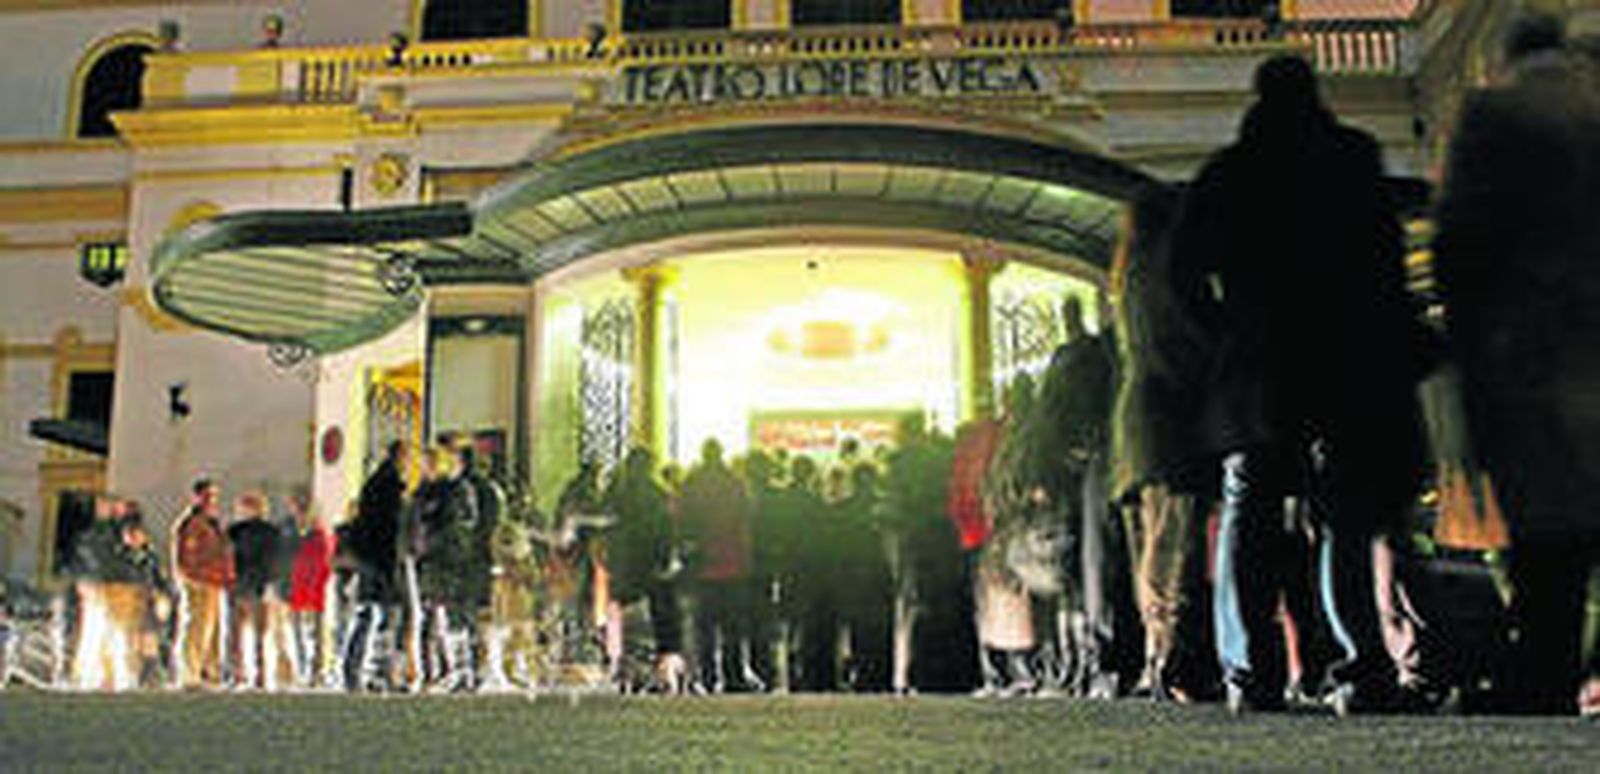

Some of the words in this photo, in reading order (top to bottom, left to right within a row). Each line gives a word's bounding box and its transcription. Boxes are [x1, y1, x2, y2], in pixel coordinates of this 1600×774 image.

[623, 64, 765, 101] TEATRO
[779, 60, 870, 96] LOPE
[881, 59, 920, 96] DE
[928, 57, 1039, 93] VEGA
